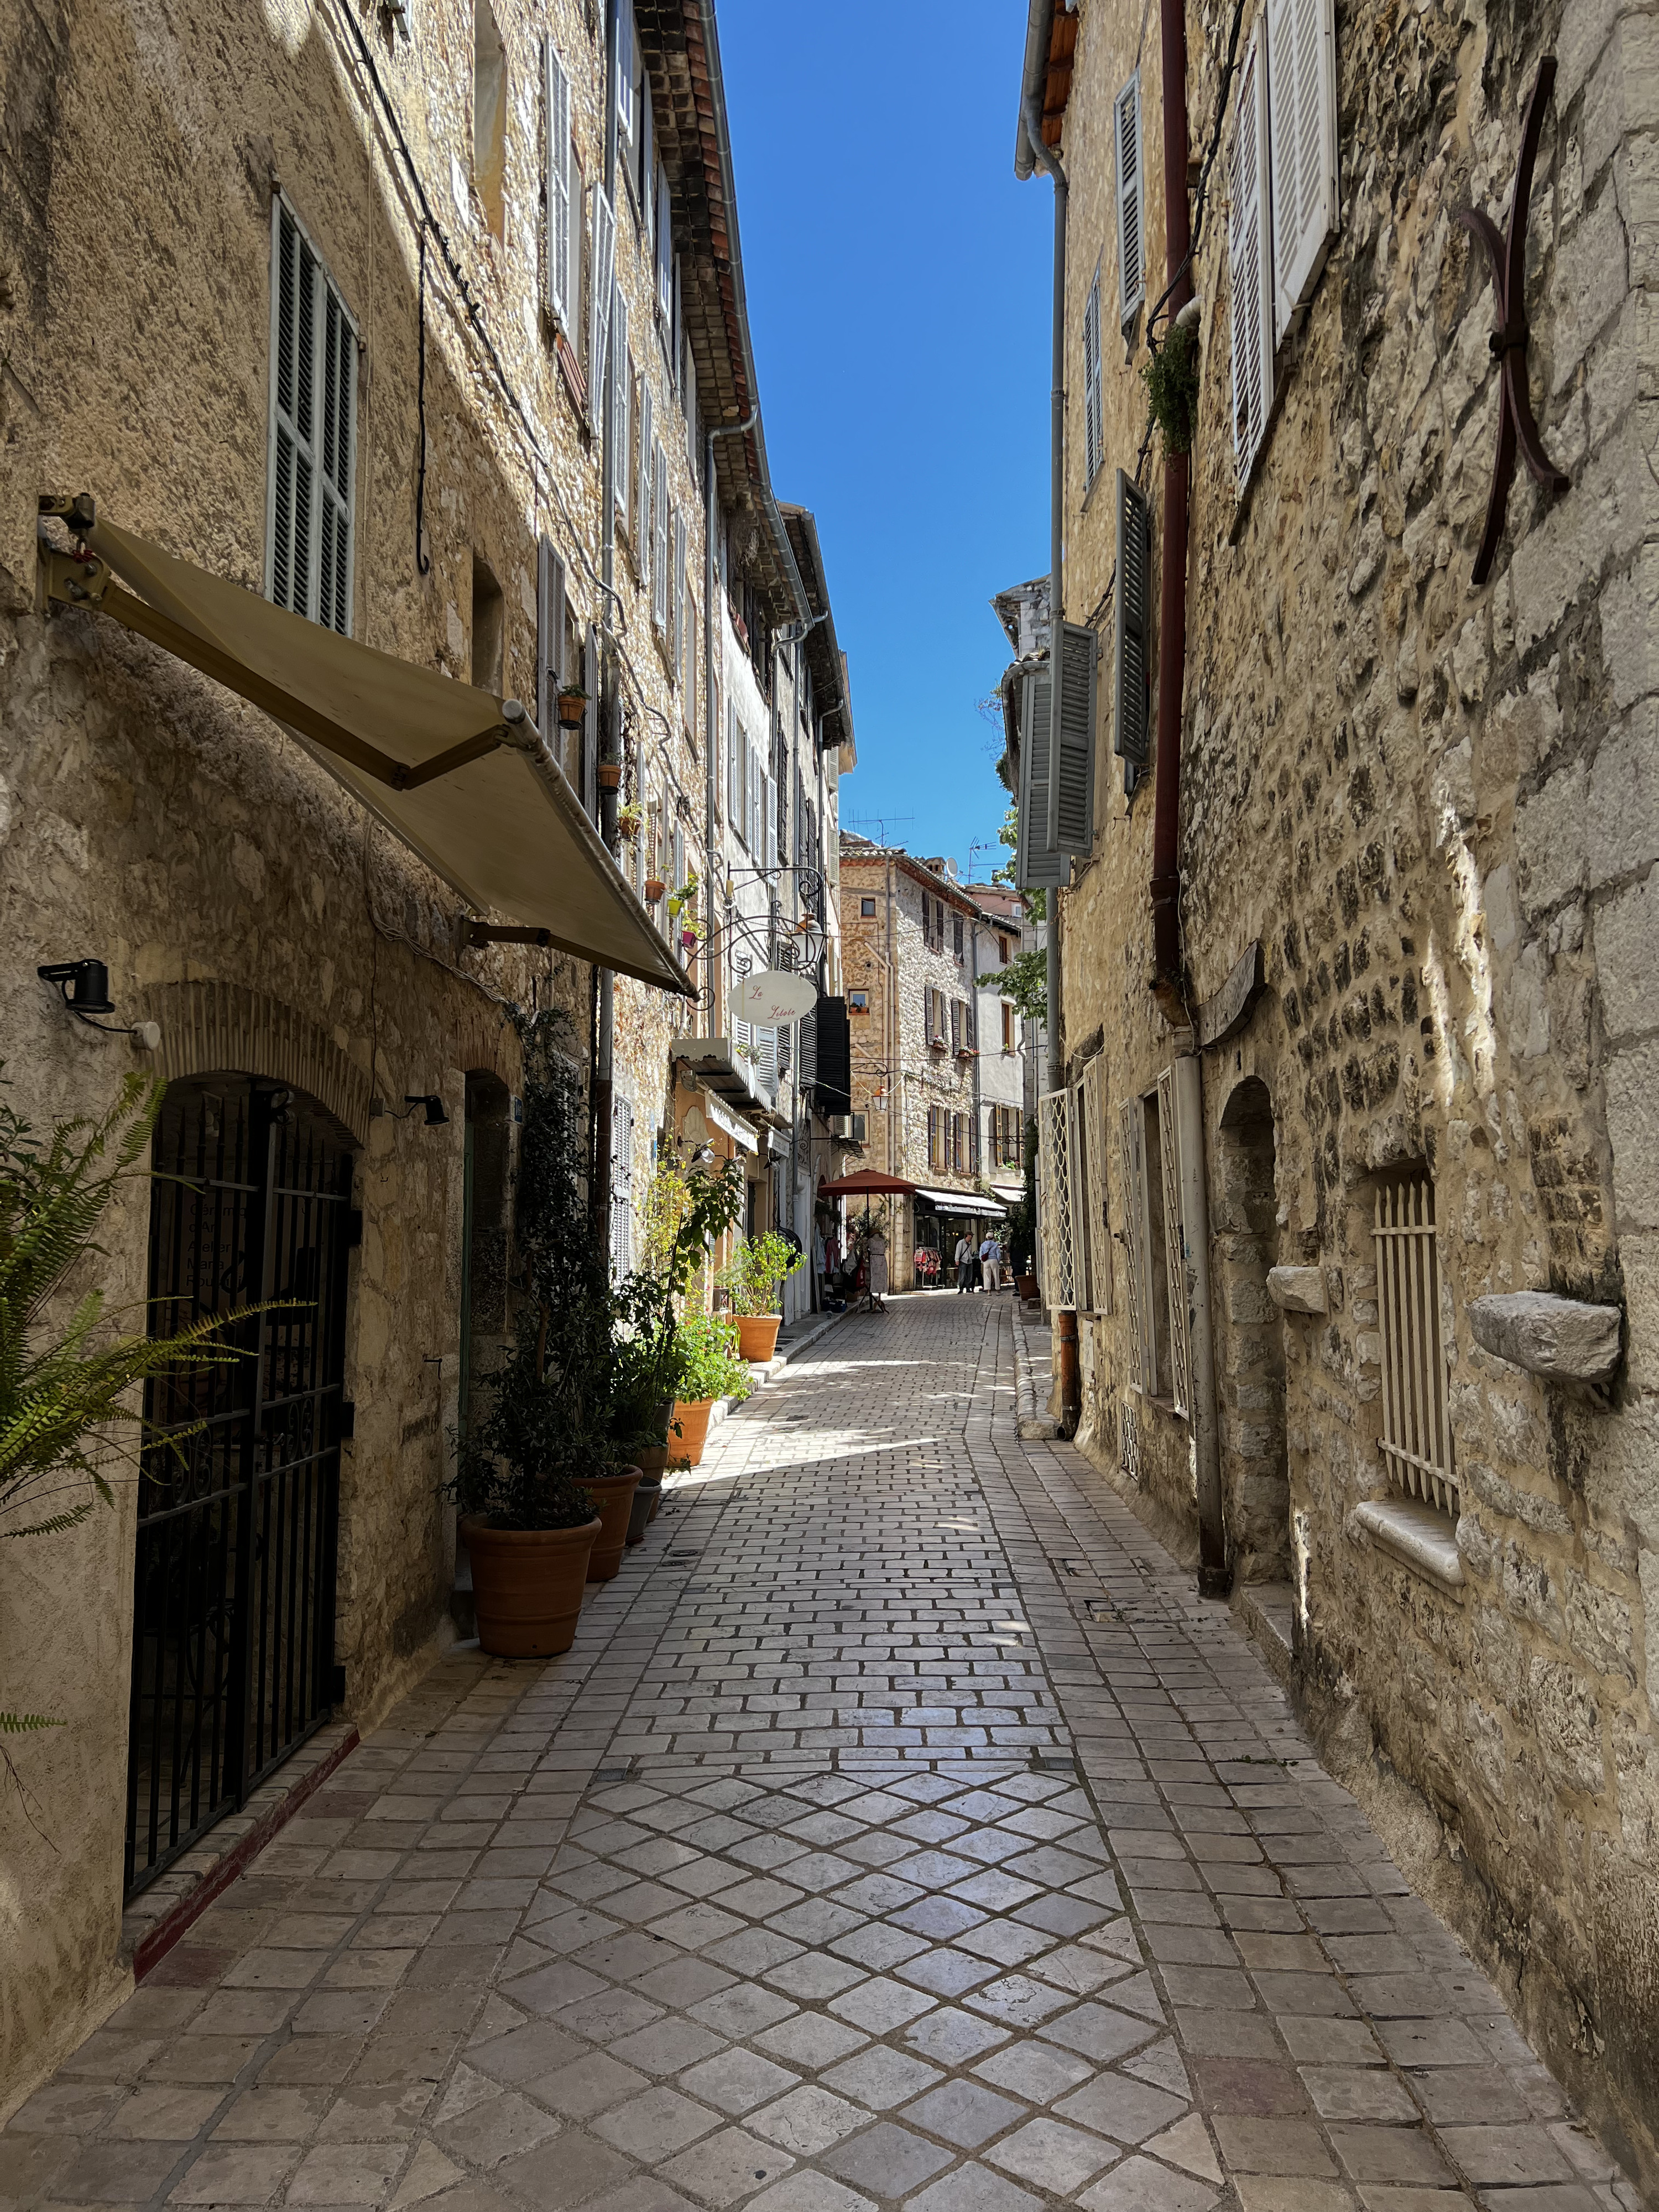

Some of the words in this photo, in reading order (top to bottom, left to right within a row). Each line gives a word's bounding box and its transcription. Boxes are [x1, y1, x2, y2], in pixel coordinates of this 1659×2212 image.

[749, 985, 764, 1000] La
[187, 1241, 231, 1253] Aeler
[187, 1258, 224, 1270] Mara
